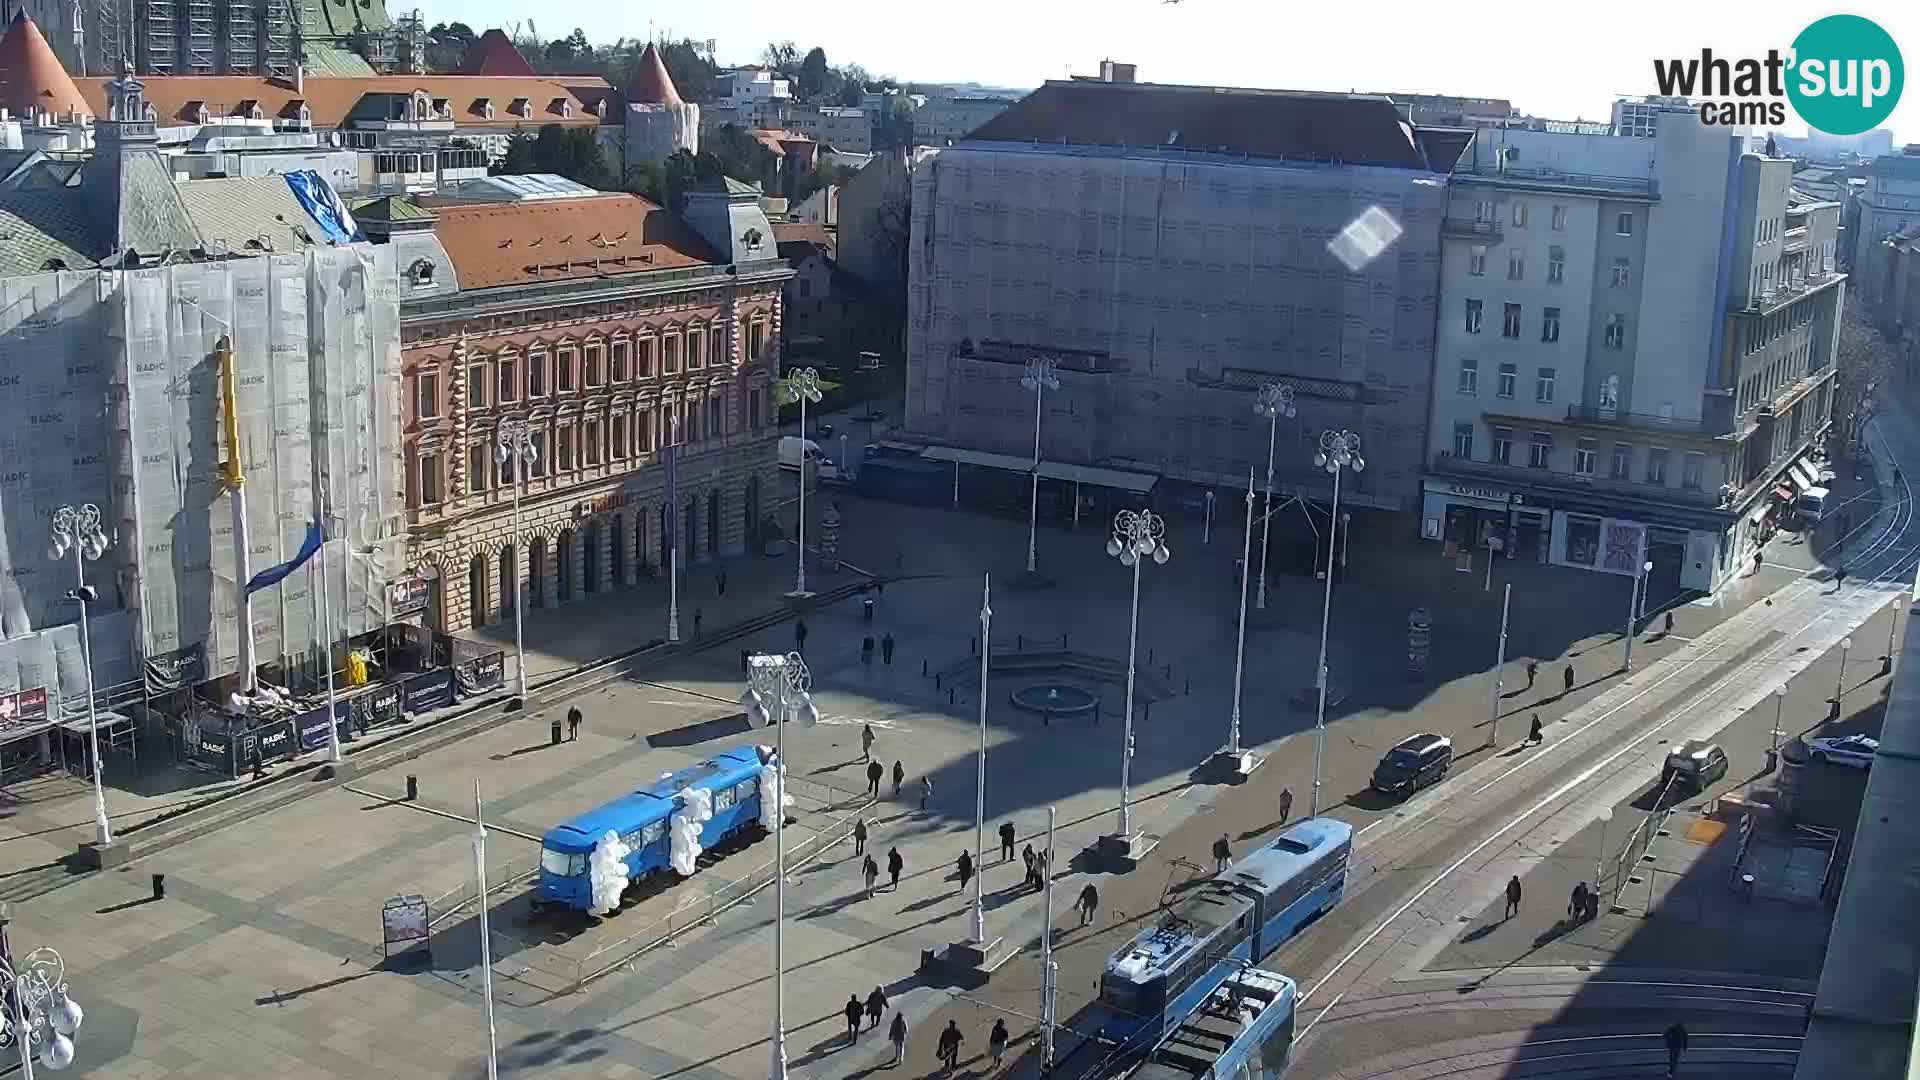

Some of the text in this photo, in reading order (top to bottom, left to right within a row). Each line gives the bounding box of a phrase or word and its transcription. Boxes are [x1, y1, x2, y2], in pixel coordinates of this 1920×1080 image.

[238, 287, 264, 297] RADIC
[137, 362, 165, 373] RADIC
[240, 375, 265, 386] RADIC
[376, 692, 398, 708] RADIC
[262, 729, 287, 745] RADIC
